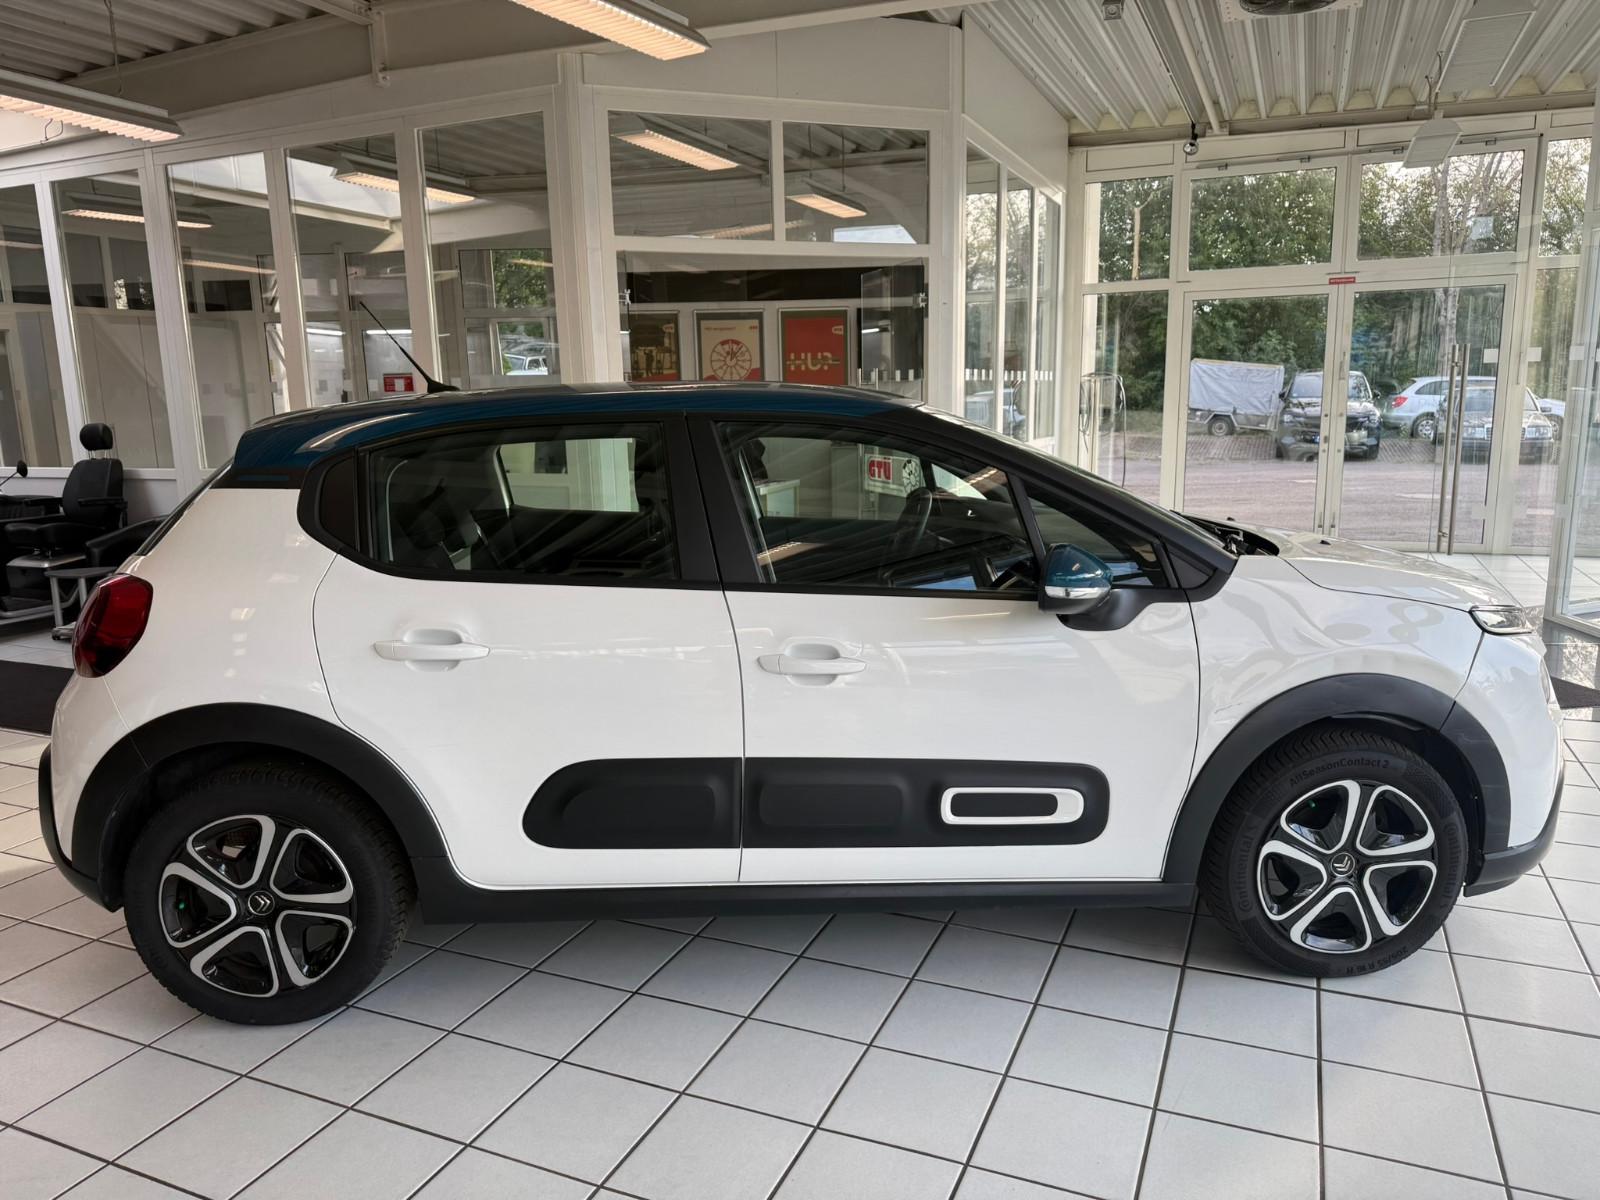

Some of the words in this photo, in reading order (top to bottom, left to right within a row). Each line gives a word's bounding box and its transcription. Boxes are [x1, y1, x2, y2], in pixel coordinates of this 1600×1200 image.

[868, 456, 892, 481] GTÜ
[1289, 757, 1381, 787] AllSeasonContact
[1382, 759, 1390, 769] 2
[1234, 835, 1254, 912] Continental
